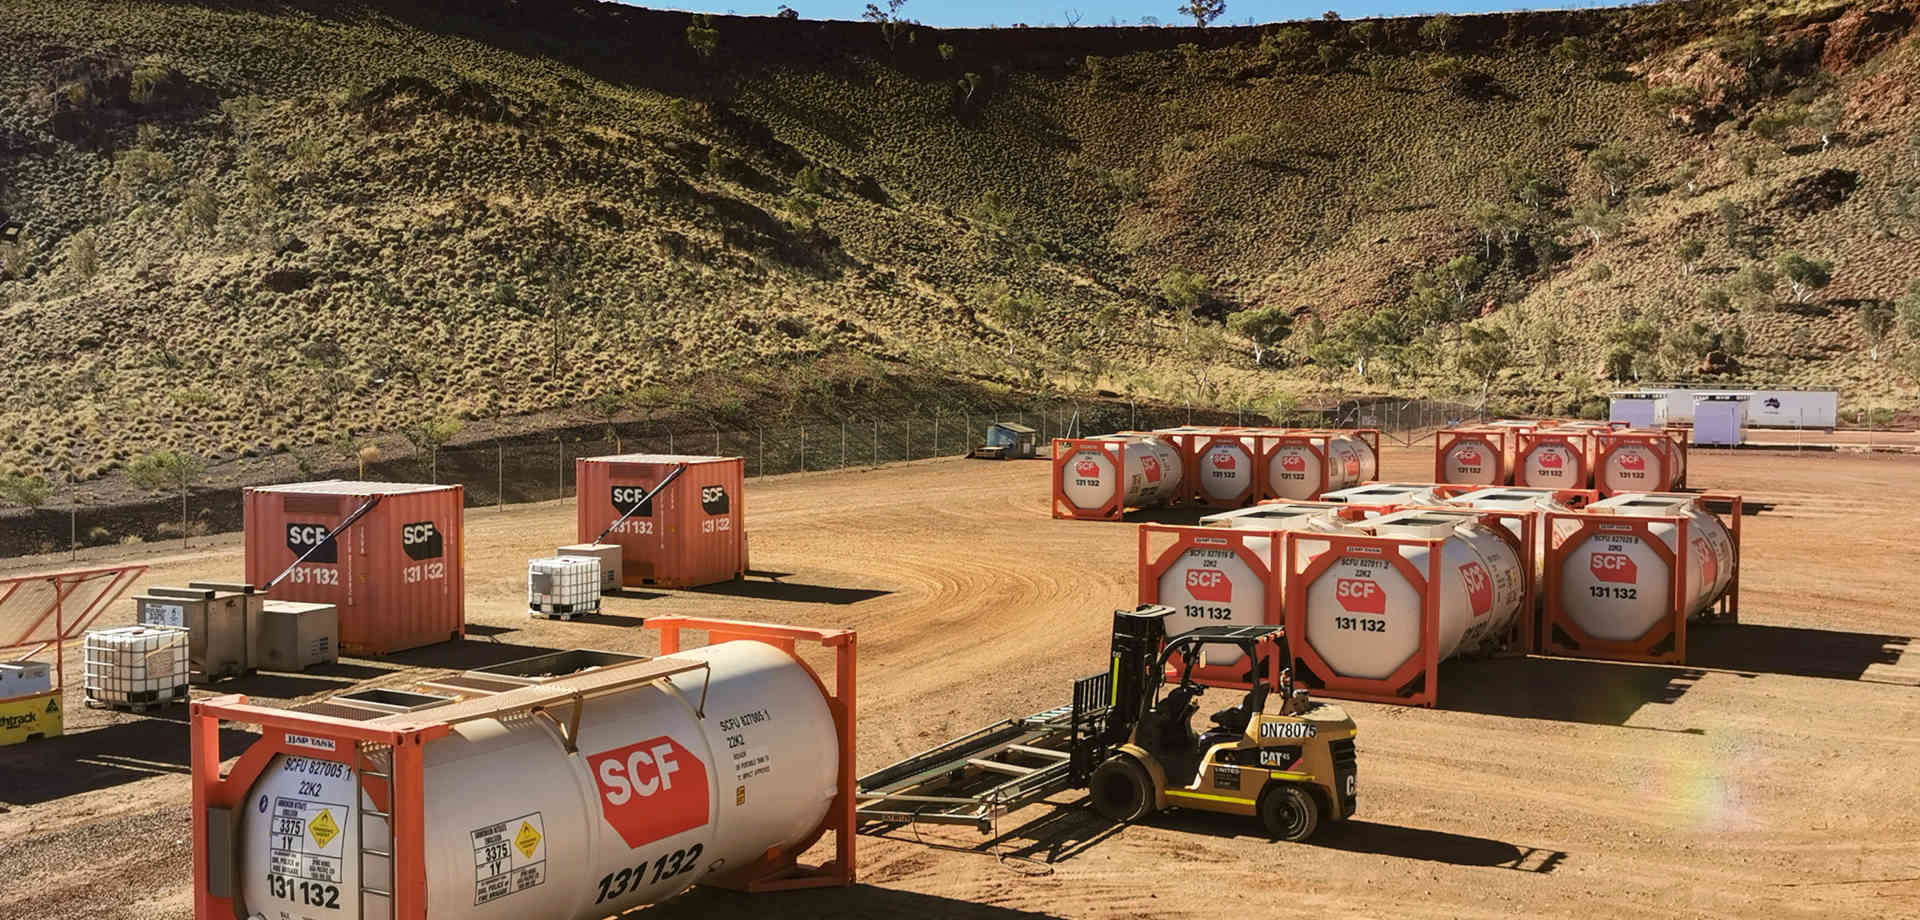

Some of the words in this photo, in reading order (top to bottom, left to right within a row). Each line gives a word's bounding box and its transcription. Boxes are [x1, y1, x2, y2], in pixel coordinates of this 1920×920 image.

[613, 488, 643, 503] SCF
[702, 487, 724, 503] SCF
[611, 520, 630, 533] 131
[632, 521, 653, 534] 132
[702, 521, 714, 534] 131
[716, 518, 730, 532] 132
[289, 525, 326, 545] SCF
[403, 524, 433, 545] SCF
[1592, 554, 1627, 570] SCF
[290, 567, 311, 584] 131
[313, 567, 339, 585] 132
[403, 565, 421, 584] 131
[423, 562, 444, 580] 132
[1188, 571, 1222, 587] SCF
[1338, 581, 1376, 598] SCF
[1589, 586, 1610, 599] 131
[1613, 587, 1637, 600] 132
[1184, 604, 1204, 618] 131
[1207, 607, 1232, 620] 132
[1335, 616, 1356, 631] 131
[1359, 618, 1386, 632] 132
[1260, 722, 1317, 738] DN78075
[284, 757, 308, 772] SCFU
[1260, 751, 1282, 767] CAT
[599, 742, 681, 806] SCF
[298, 780, 323, 798] 22K2
[280, 819, 301, 835] 3375
[282, 836, 294, 851] 1Y
[485, 843, 508, 862] 3375
[489, 861, 502, 876] 1Y
[595, 861, 649, 905] 131
[650, 842, 704, 886] 132
[267, 873, 296, 902] 131
[300, 881, 341, 910] 132
